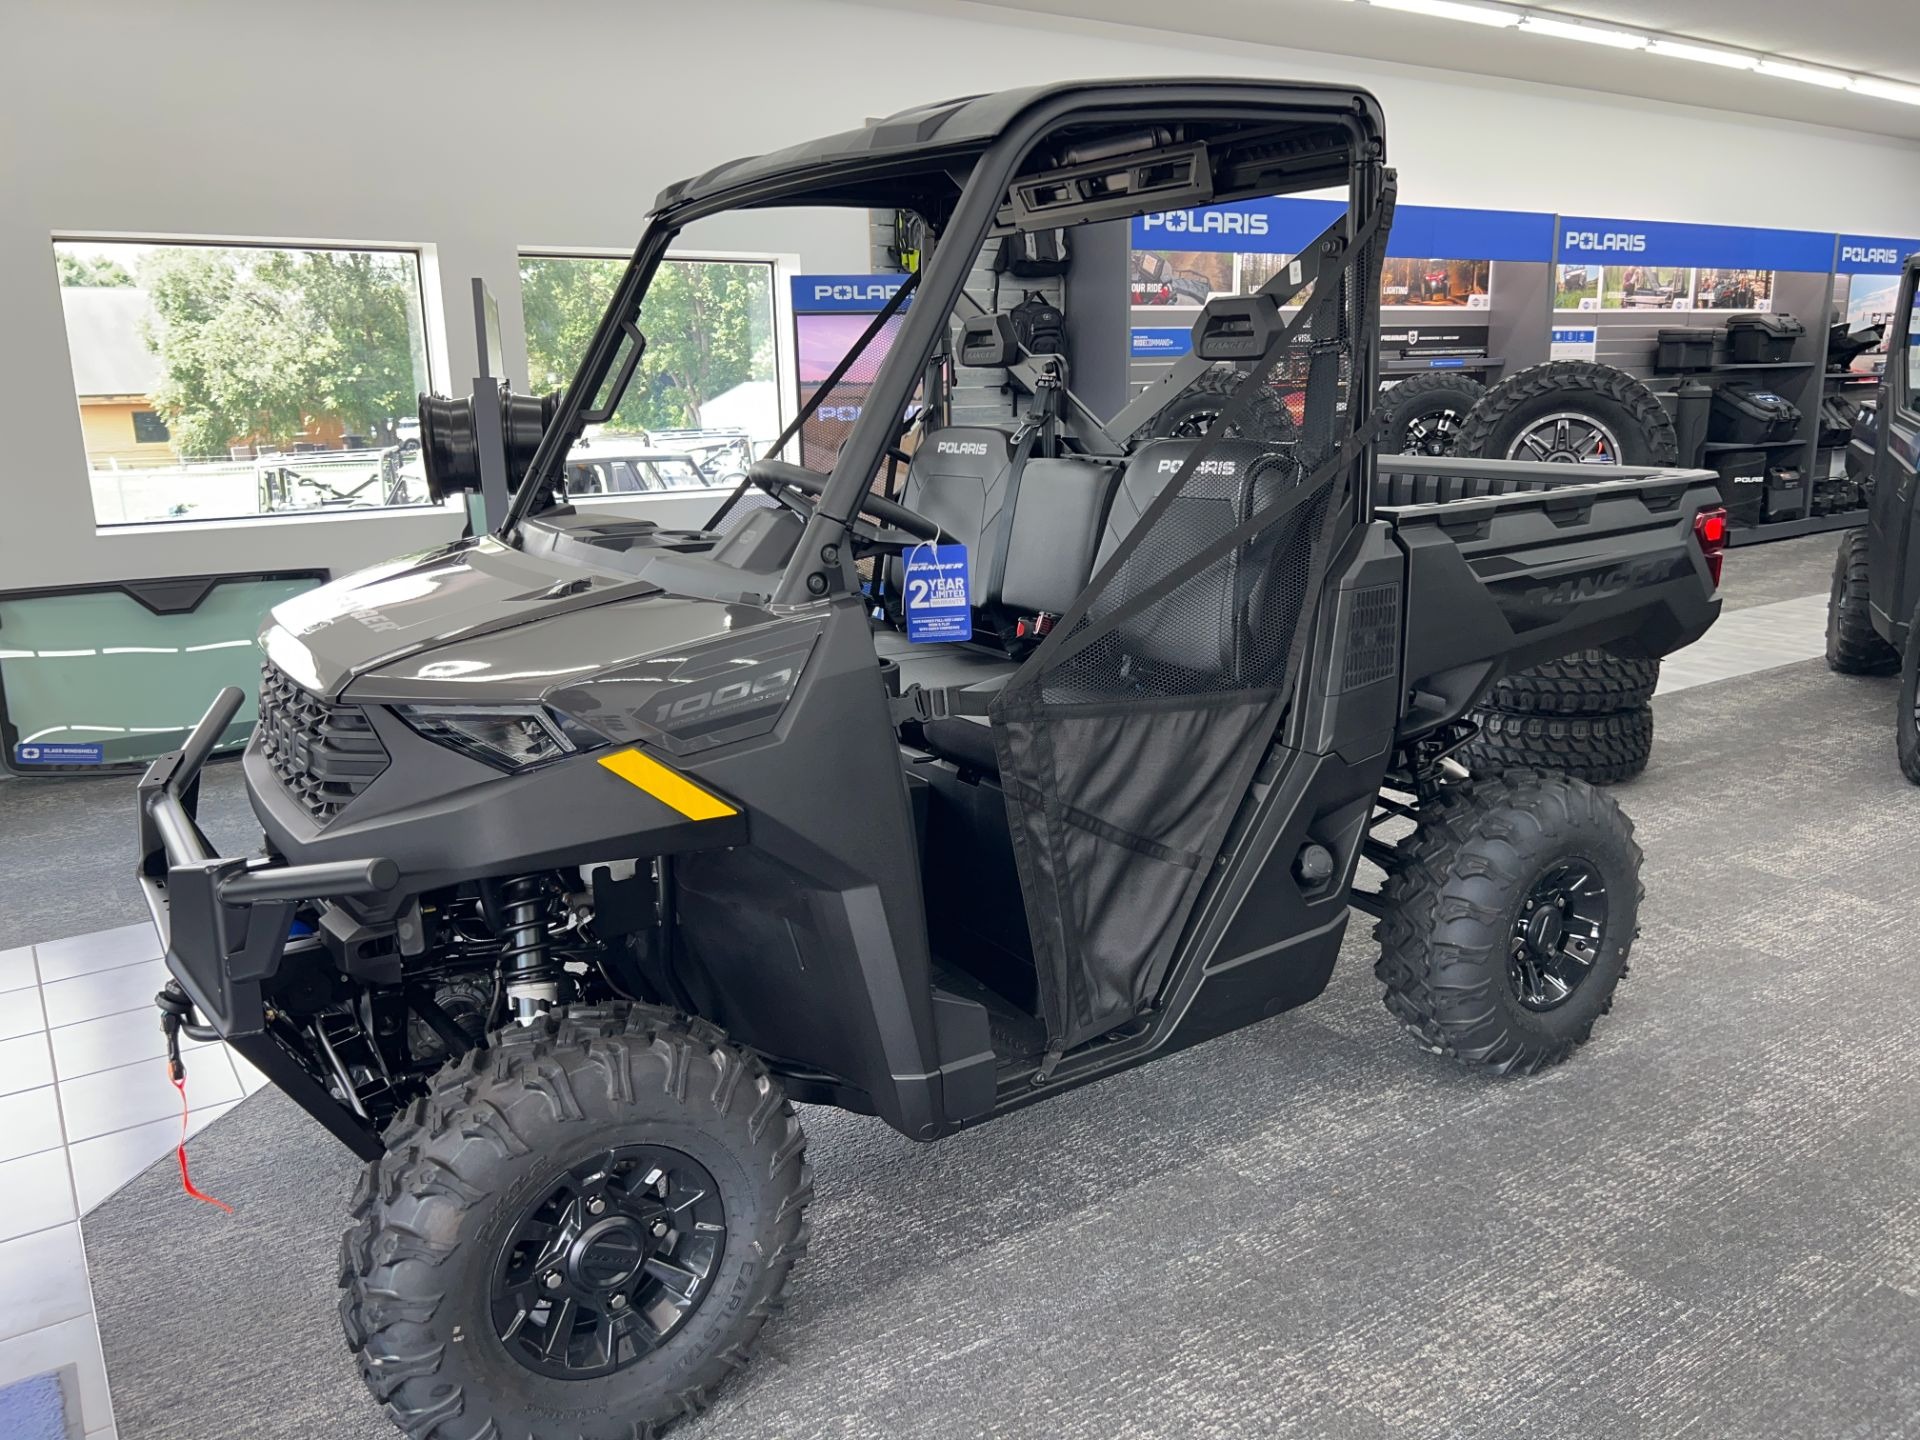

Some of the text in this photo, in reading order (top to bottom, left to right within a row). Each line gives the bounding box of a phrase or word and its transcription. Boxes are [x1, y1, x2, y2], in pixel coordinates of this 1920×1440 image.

[1144, 211, 1269, 235] POLARIS
[1565, 231, 1647, 252] POLARIS
[1841, 246, 1898, 264] POLARIS
[814, 284, 917, 300] POLAR
[937, 441, 988, 456] POLARIS
[1157, 459, 1236, 476] POARIS
[909, 577, 965, 609] 2 YEAR
[930, 589, 966, 599] LIMITED
[654, 668, 793, 723] 1000
